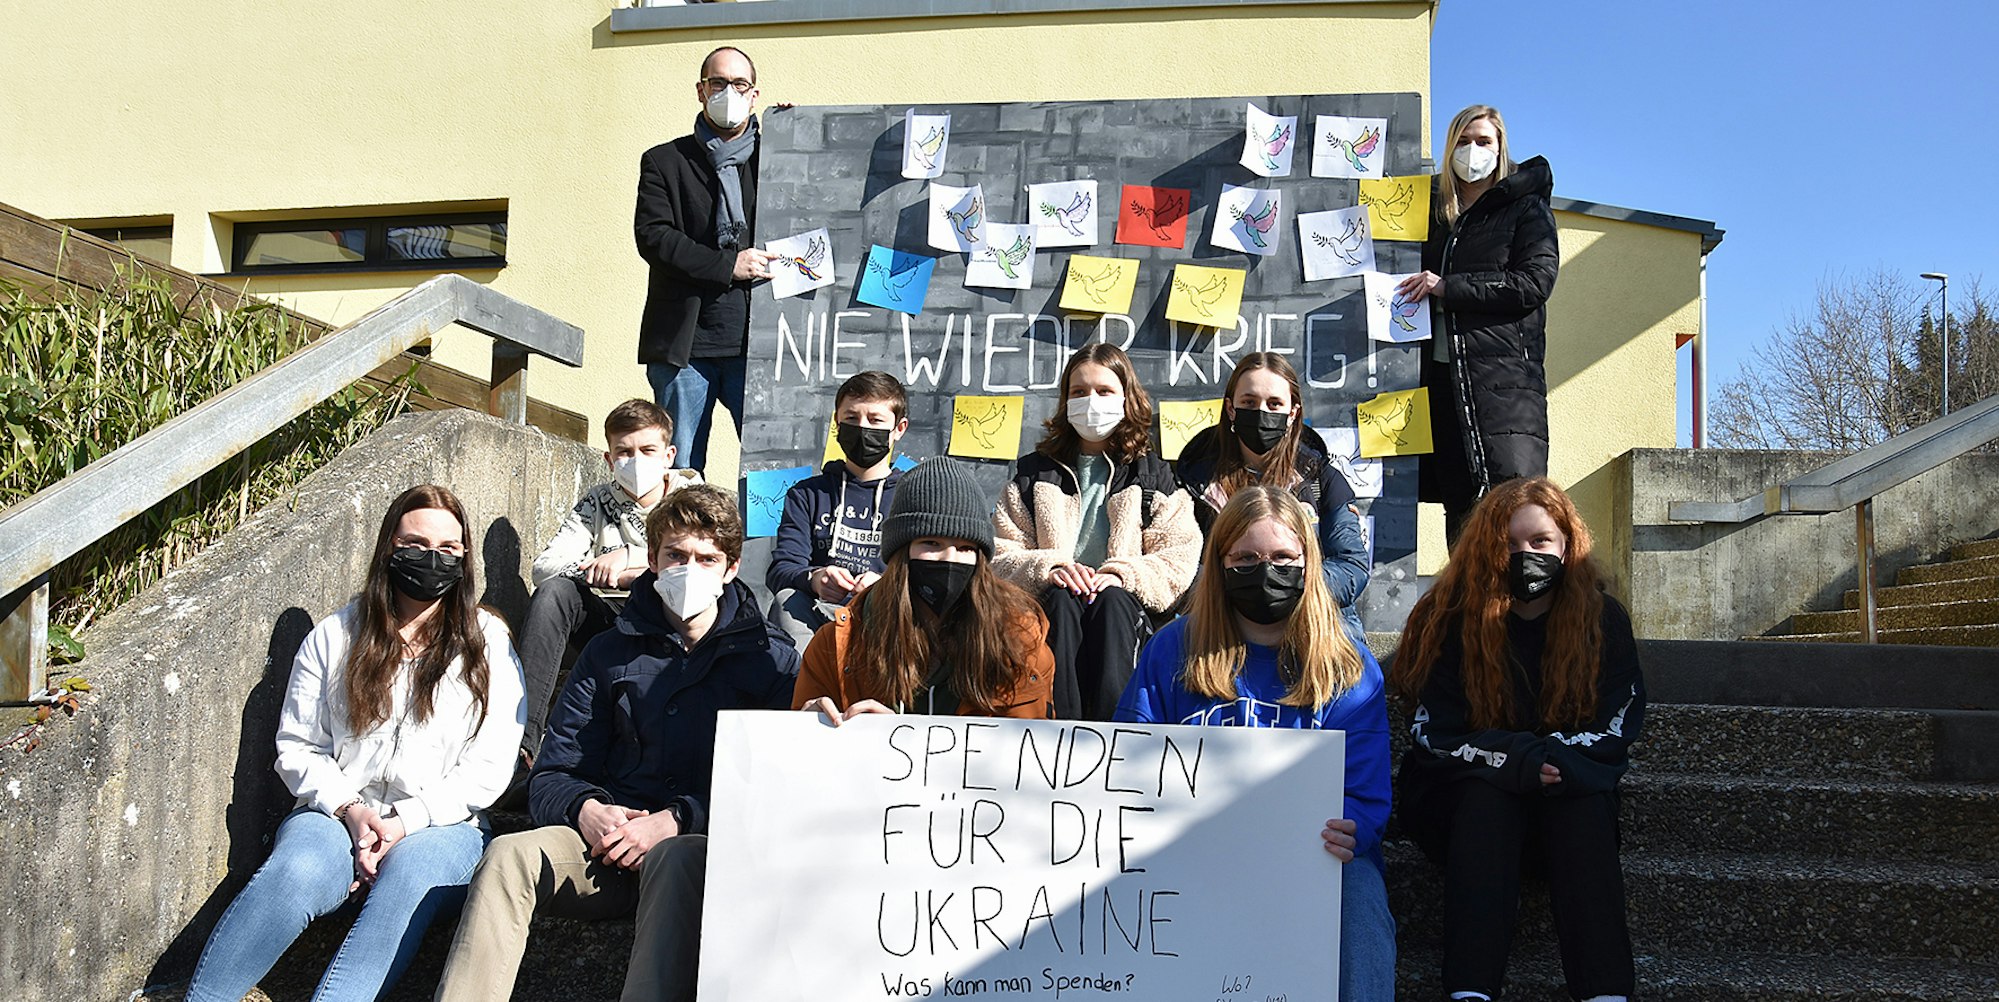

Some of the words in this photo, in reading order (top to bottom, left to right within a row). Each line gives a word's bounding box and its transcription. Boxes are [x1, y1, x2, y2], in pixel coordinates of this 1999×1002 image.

[774, 311, 872, 382] NIE
[883, 722, 1204, 799] SPENDEN
[883, 792, 1006, 870] FÜR
[1051, 800, 1163, 874] DIE
[877, 882, 1180, 958] UKRAINE
[881, 972, 932, 997] Was
[994, 976, 1032, 994] man
[1041, 967, 1135, 1001] Spenden?
[1221, 974, 1252, 994] Wo?
